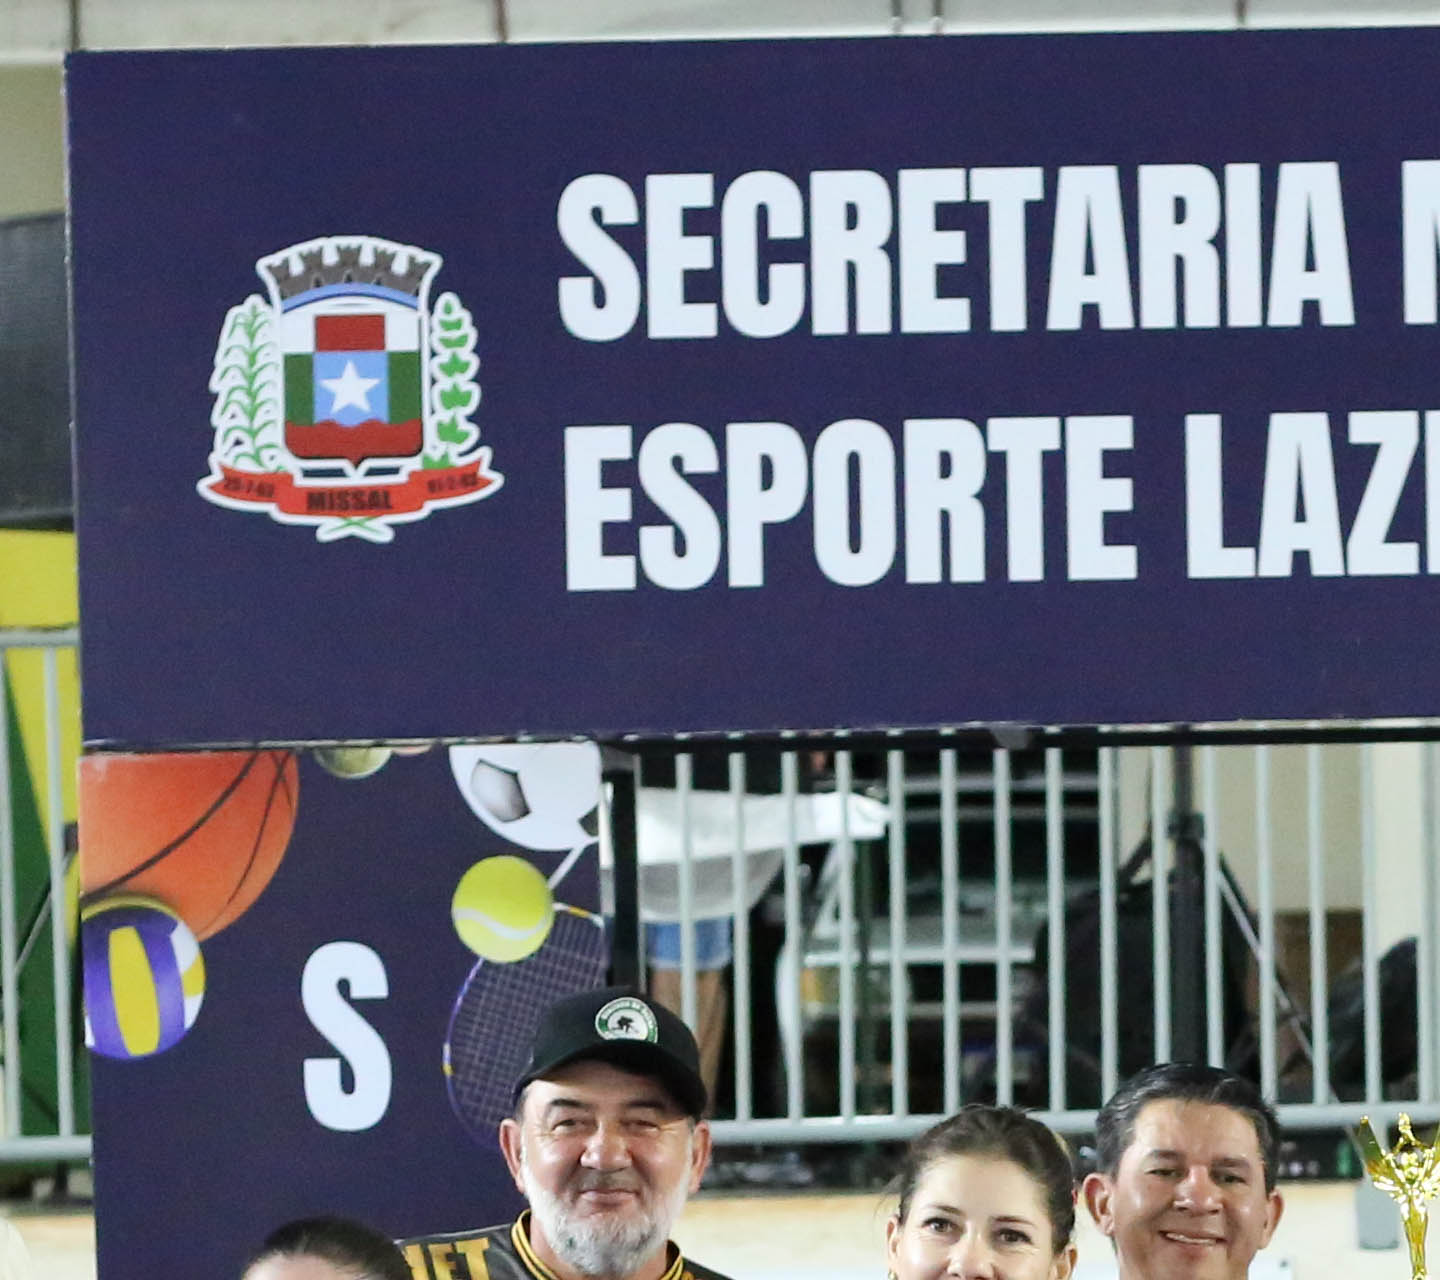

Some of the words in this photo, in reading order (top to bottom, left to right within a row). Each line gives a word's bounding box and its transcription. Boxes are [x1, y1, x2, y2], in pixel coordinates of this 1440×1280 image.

[558, 162, 1354, 341] SECRETARIA
[565, 416, 1137, 590] ESPORTE
[302, 942, 391, 1131] S
